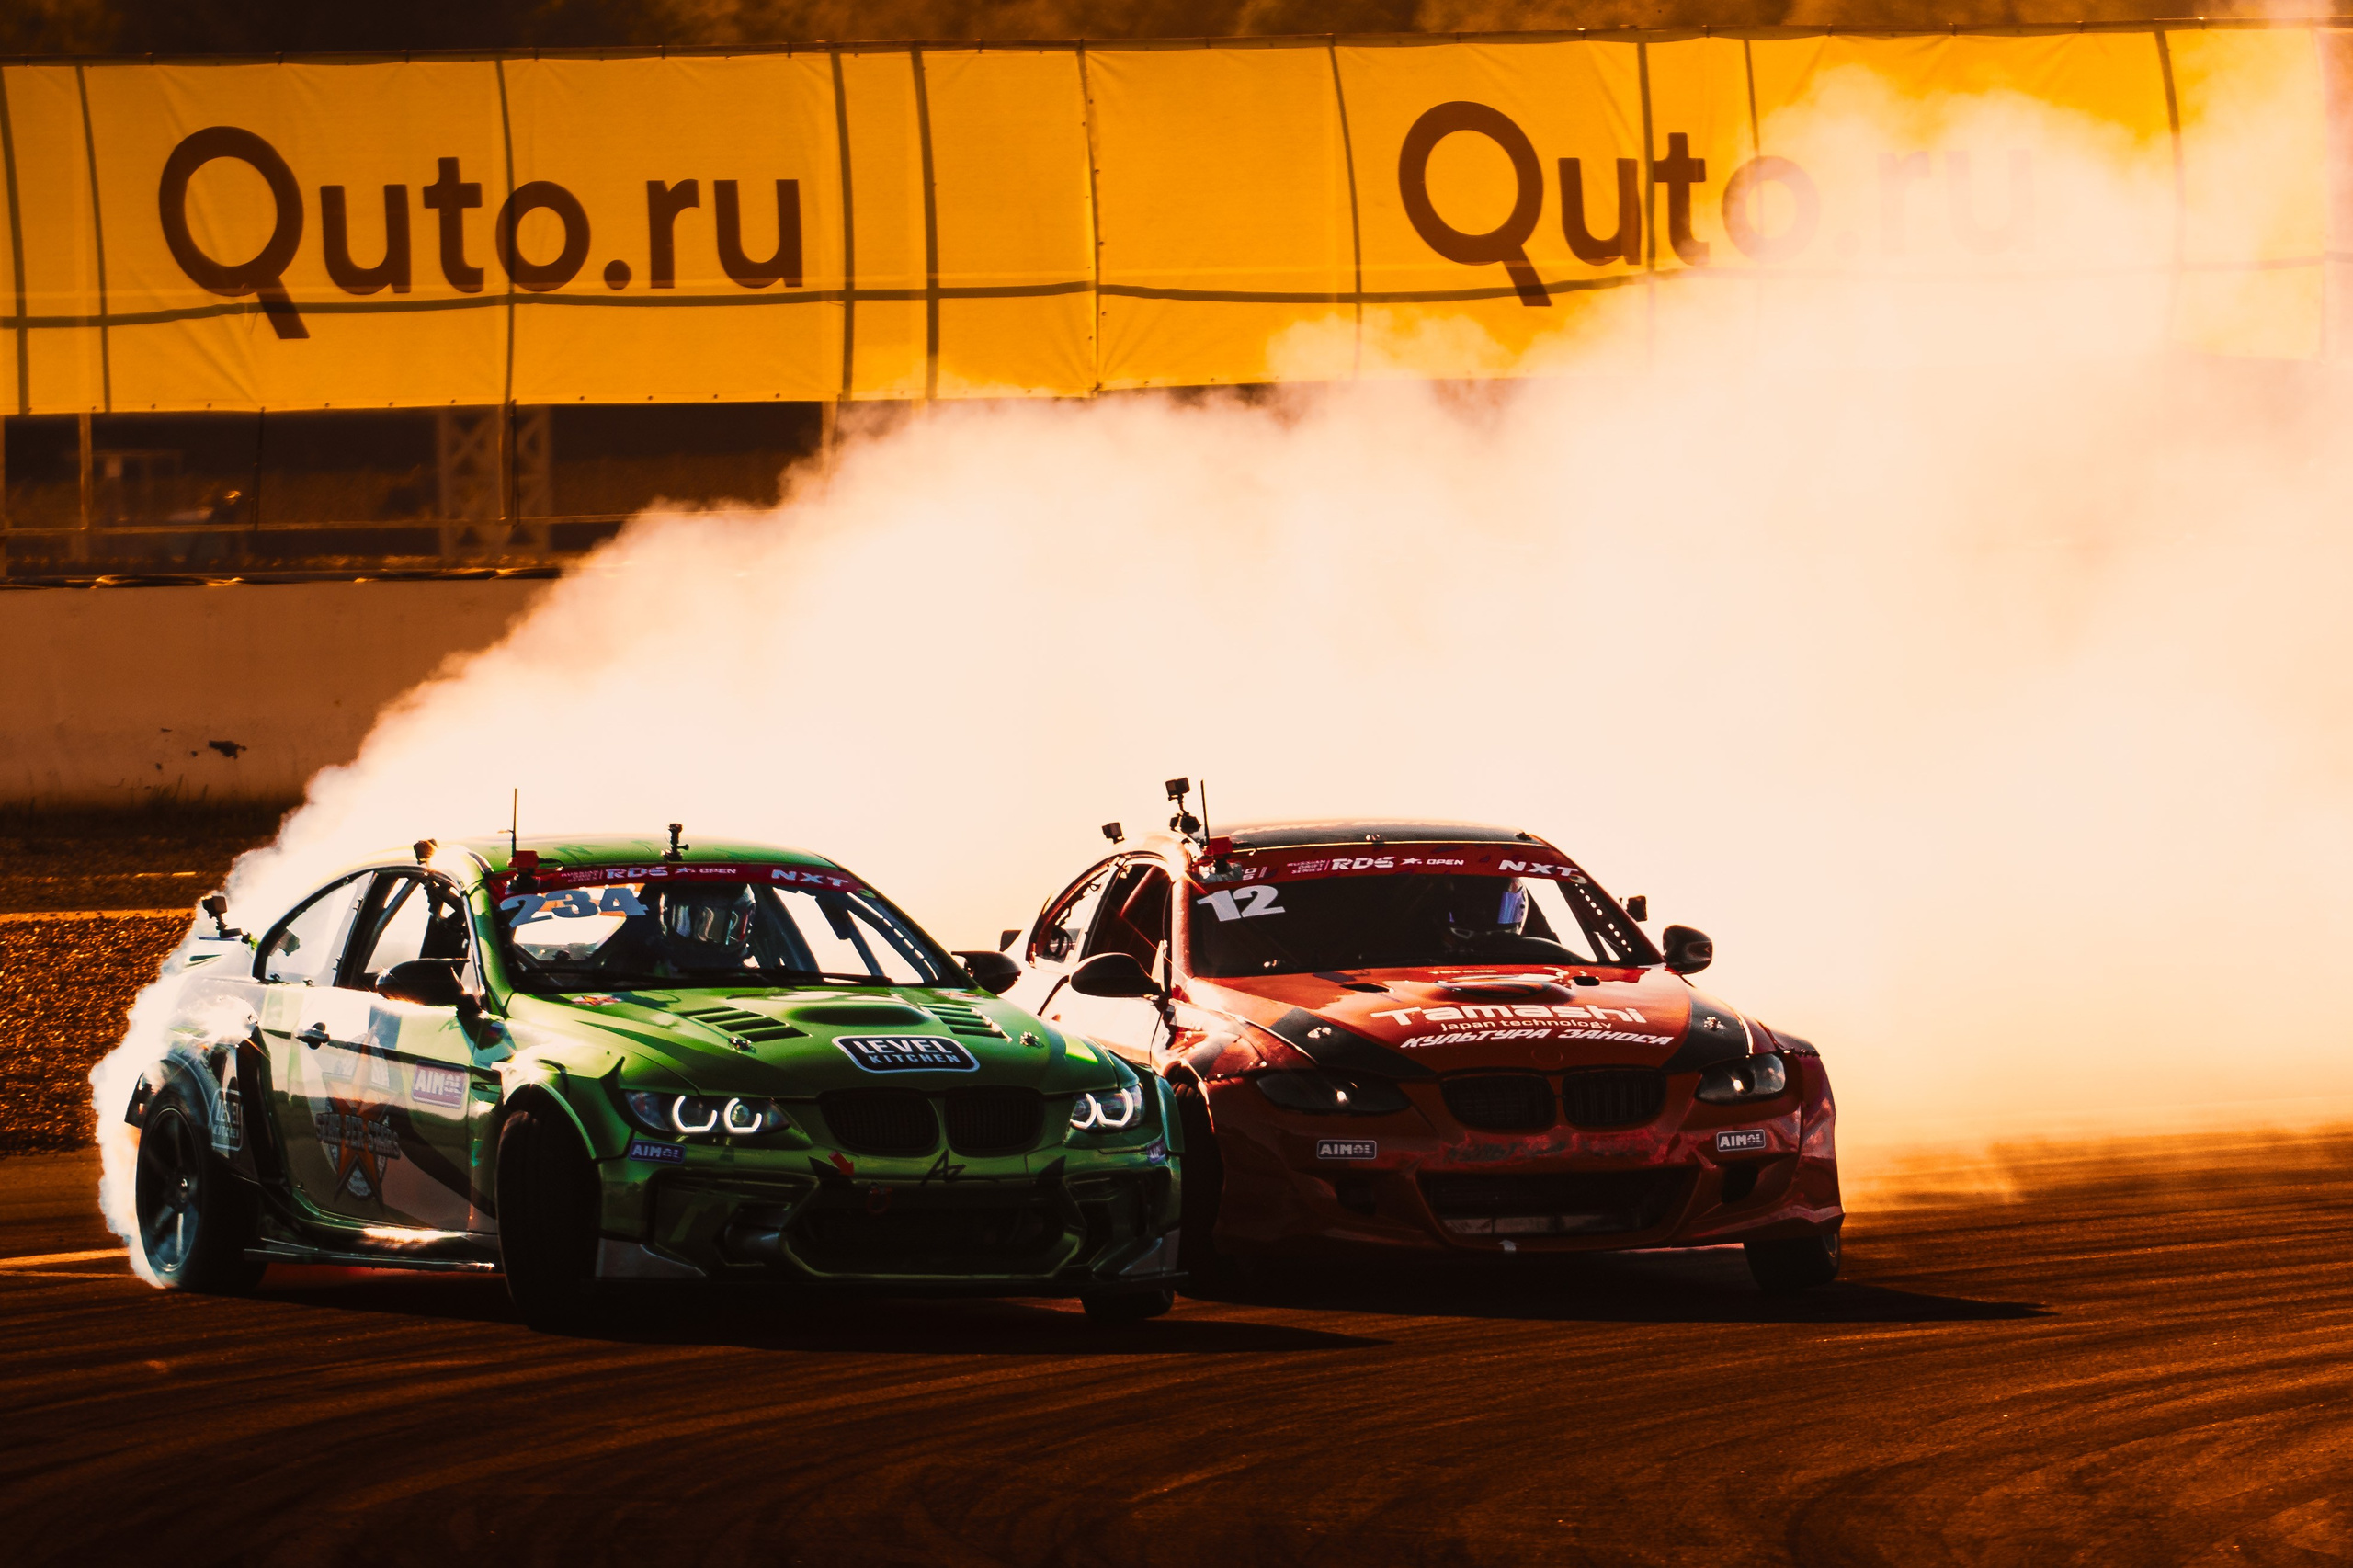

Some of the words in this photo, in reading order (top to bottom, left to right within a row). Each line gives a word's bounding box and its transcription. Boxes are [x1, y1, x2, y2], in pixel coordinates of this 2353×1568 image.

[1397, 99, 2035, 307] Quto.ru
[158, 125, 803, 340] Quto.ru
[1331, 856, 1396, 870] RDS
[1498, 859, 1580, 878] NXT
[606, 866, 668, 879] RDS
[771, 869, 849, 887] NXT
[499, 888, 649, 928] 234
[1197, 884, 1286, 922] 12
[1370, 1005, 1647, 1027] Tamashi
[1501, 1018, 1612, 1030] technology
[852, 1040, 953, 1054] LEVEL
[1400, 1028, 1552, 1049] КУЛЬТУРА
[1558, 1028, 1675, 1046] ЗАНОСА
[868, 1054, 961, 1064] KITCHEN
[1320, 1143, 1373, 1155] AIMOL
[1720, 1133, 1763, 1148] AIMOL
